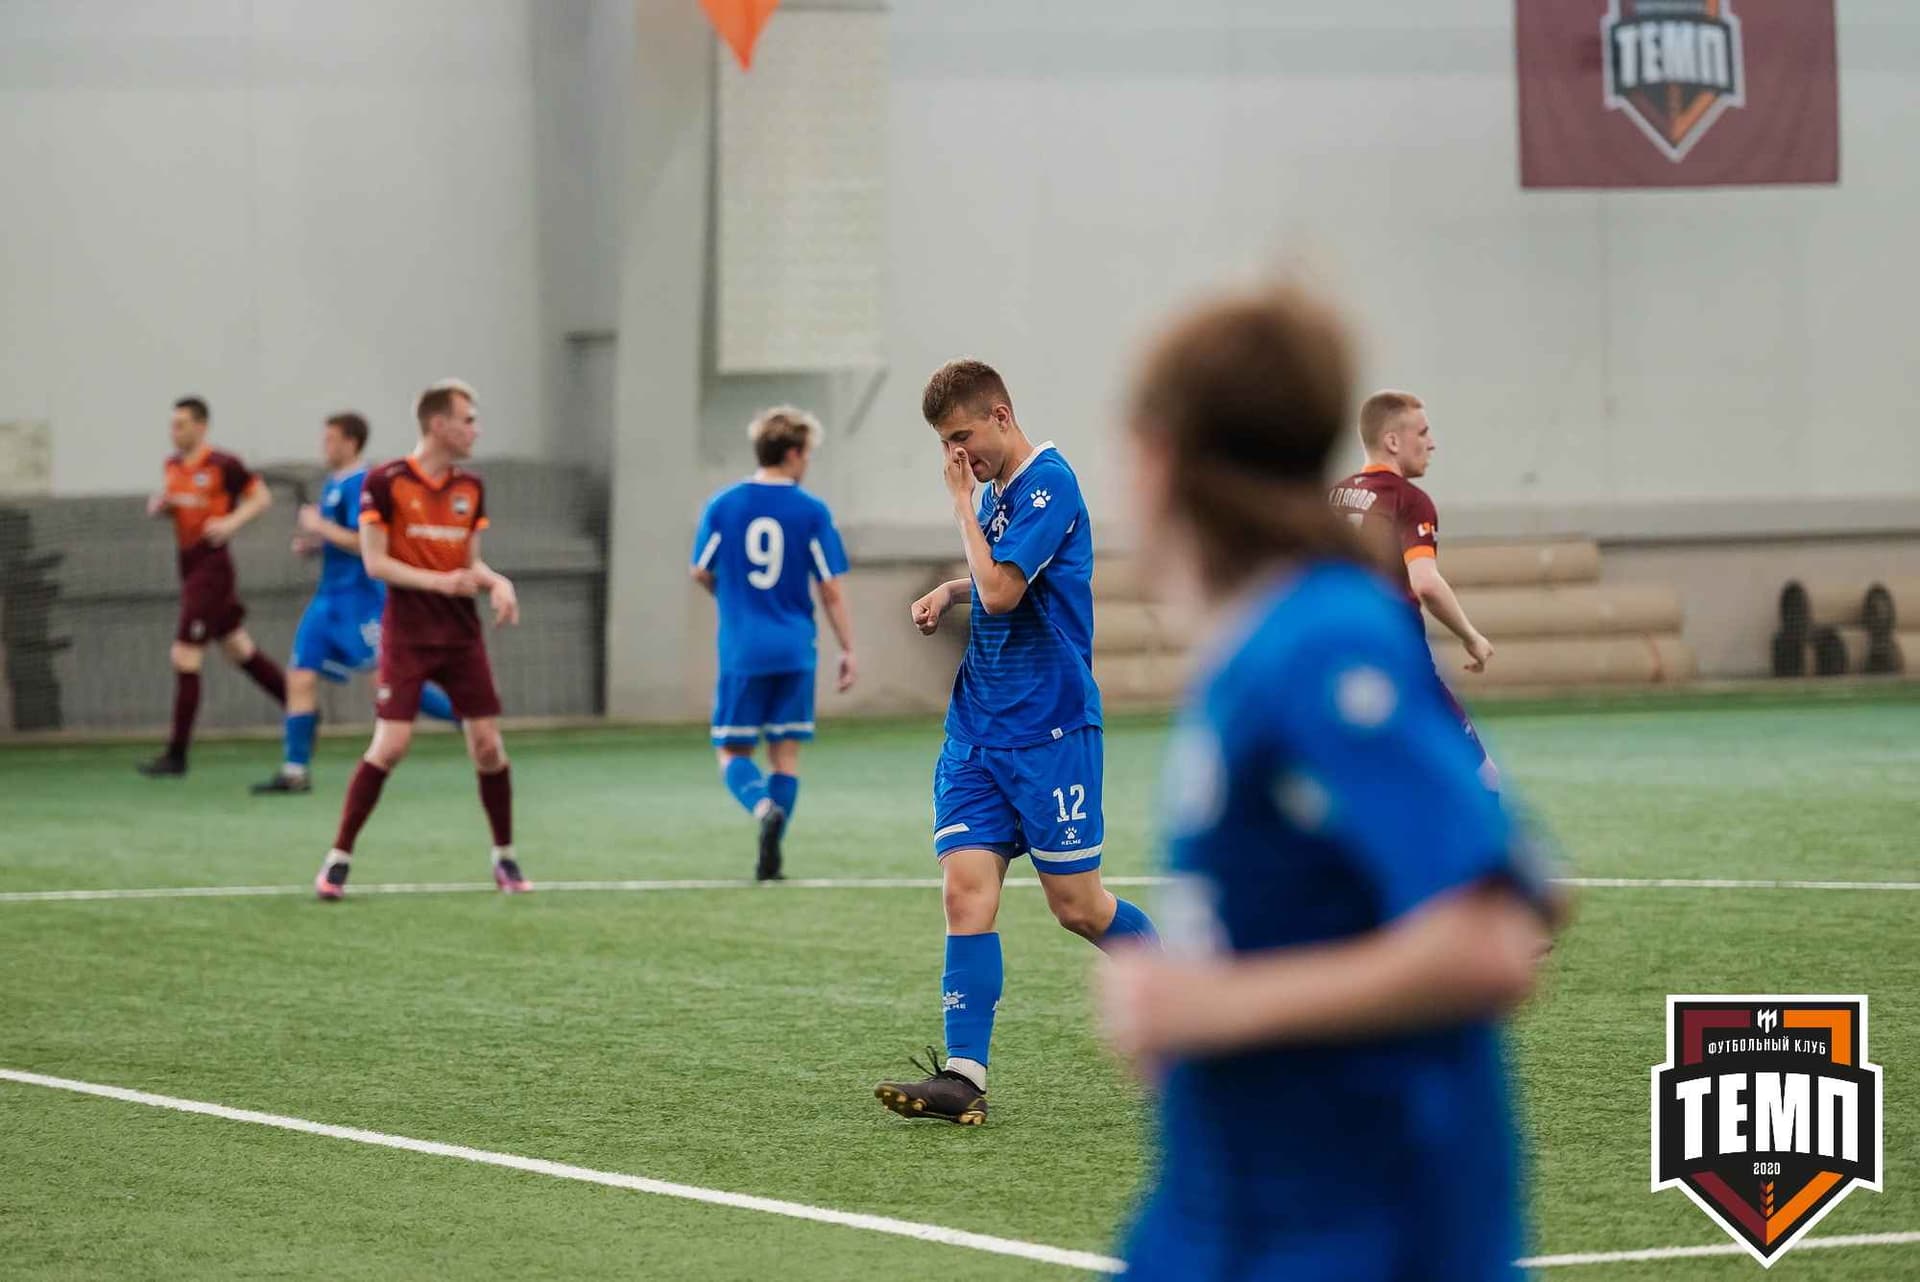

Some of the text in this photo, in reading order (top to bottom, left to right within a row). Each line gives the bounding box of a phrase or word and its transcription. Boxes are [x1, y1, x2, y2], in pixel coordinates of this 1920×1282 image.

[1614, 21, 1729, 87] ТЕМП
[745, 516, 785, 590] 9
[1053, 784, 1086, 822] 12
